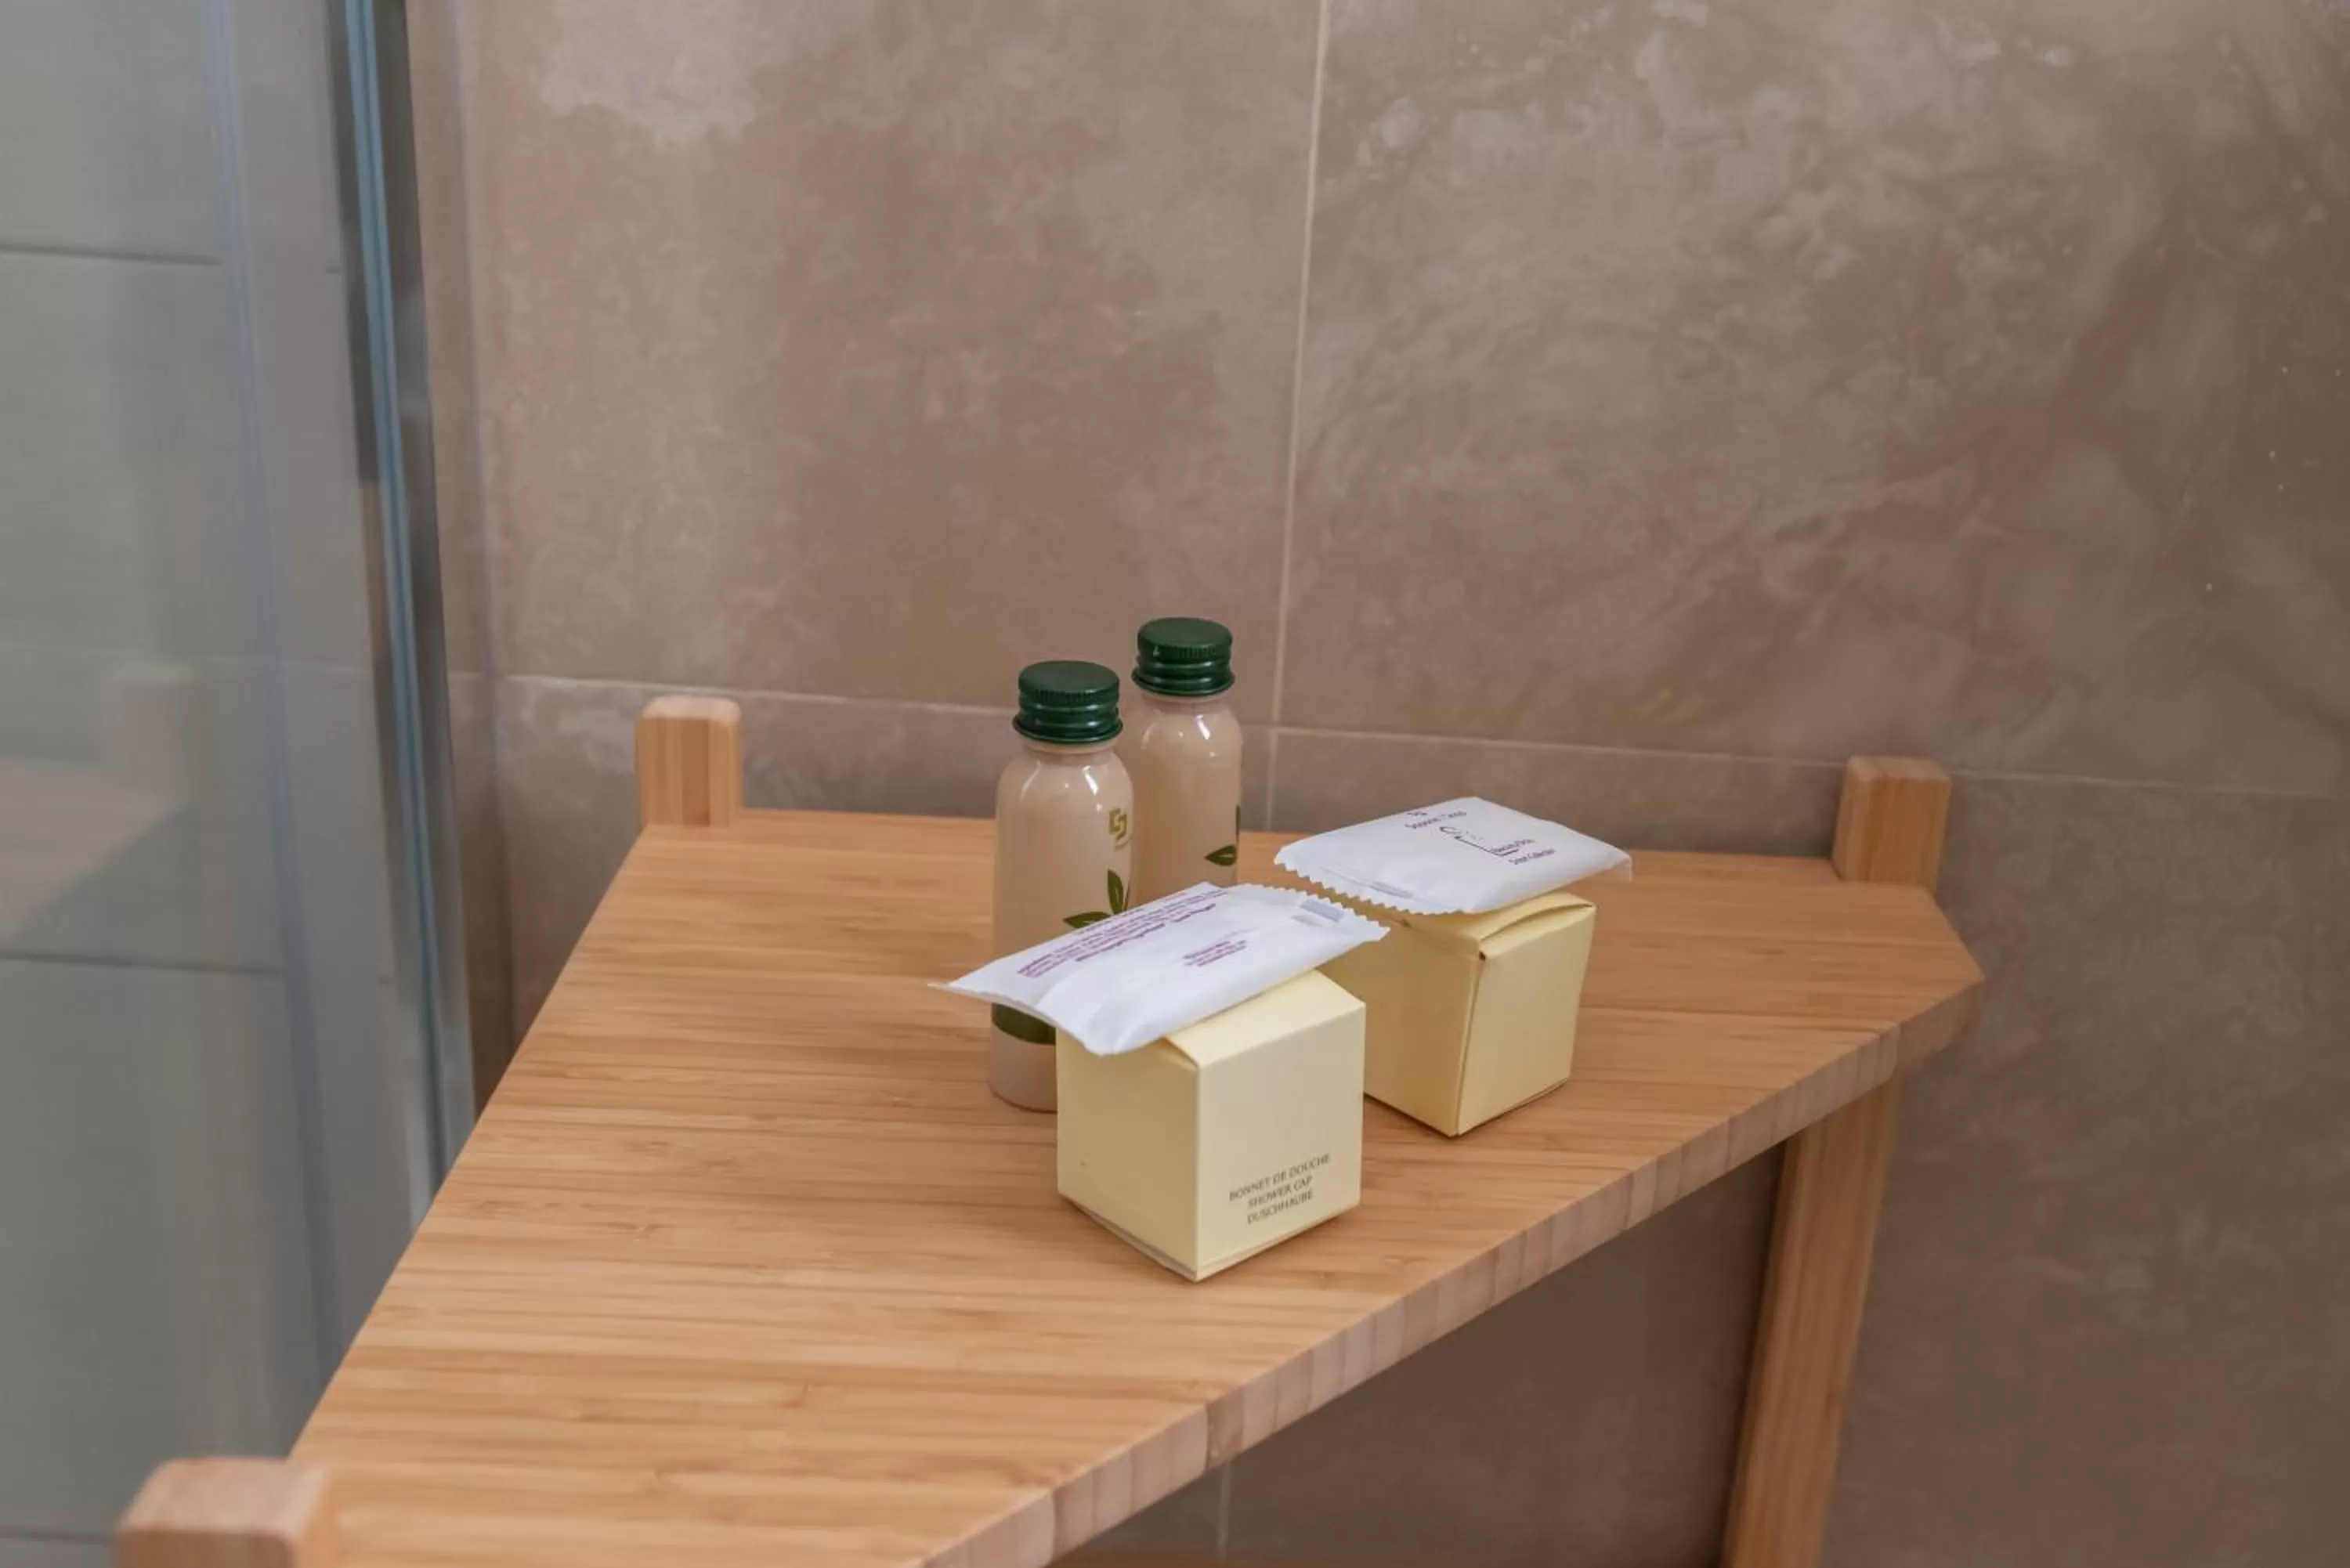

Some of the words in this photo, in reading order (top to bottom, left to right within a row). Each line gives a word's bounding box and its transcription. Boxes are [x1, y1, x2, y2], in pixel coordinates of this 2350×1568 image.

[1229, 1176, 1271, 1201] BONNET
[1272, 1169, 1287, 1186] DE
[1248, 1183, 1292, 1209] SHOWER
[1293, 1174, 1314, 1192] CAP
